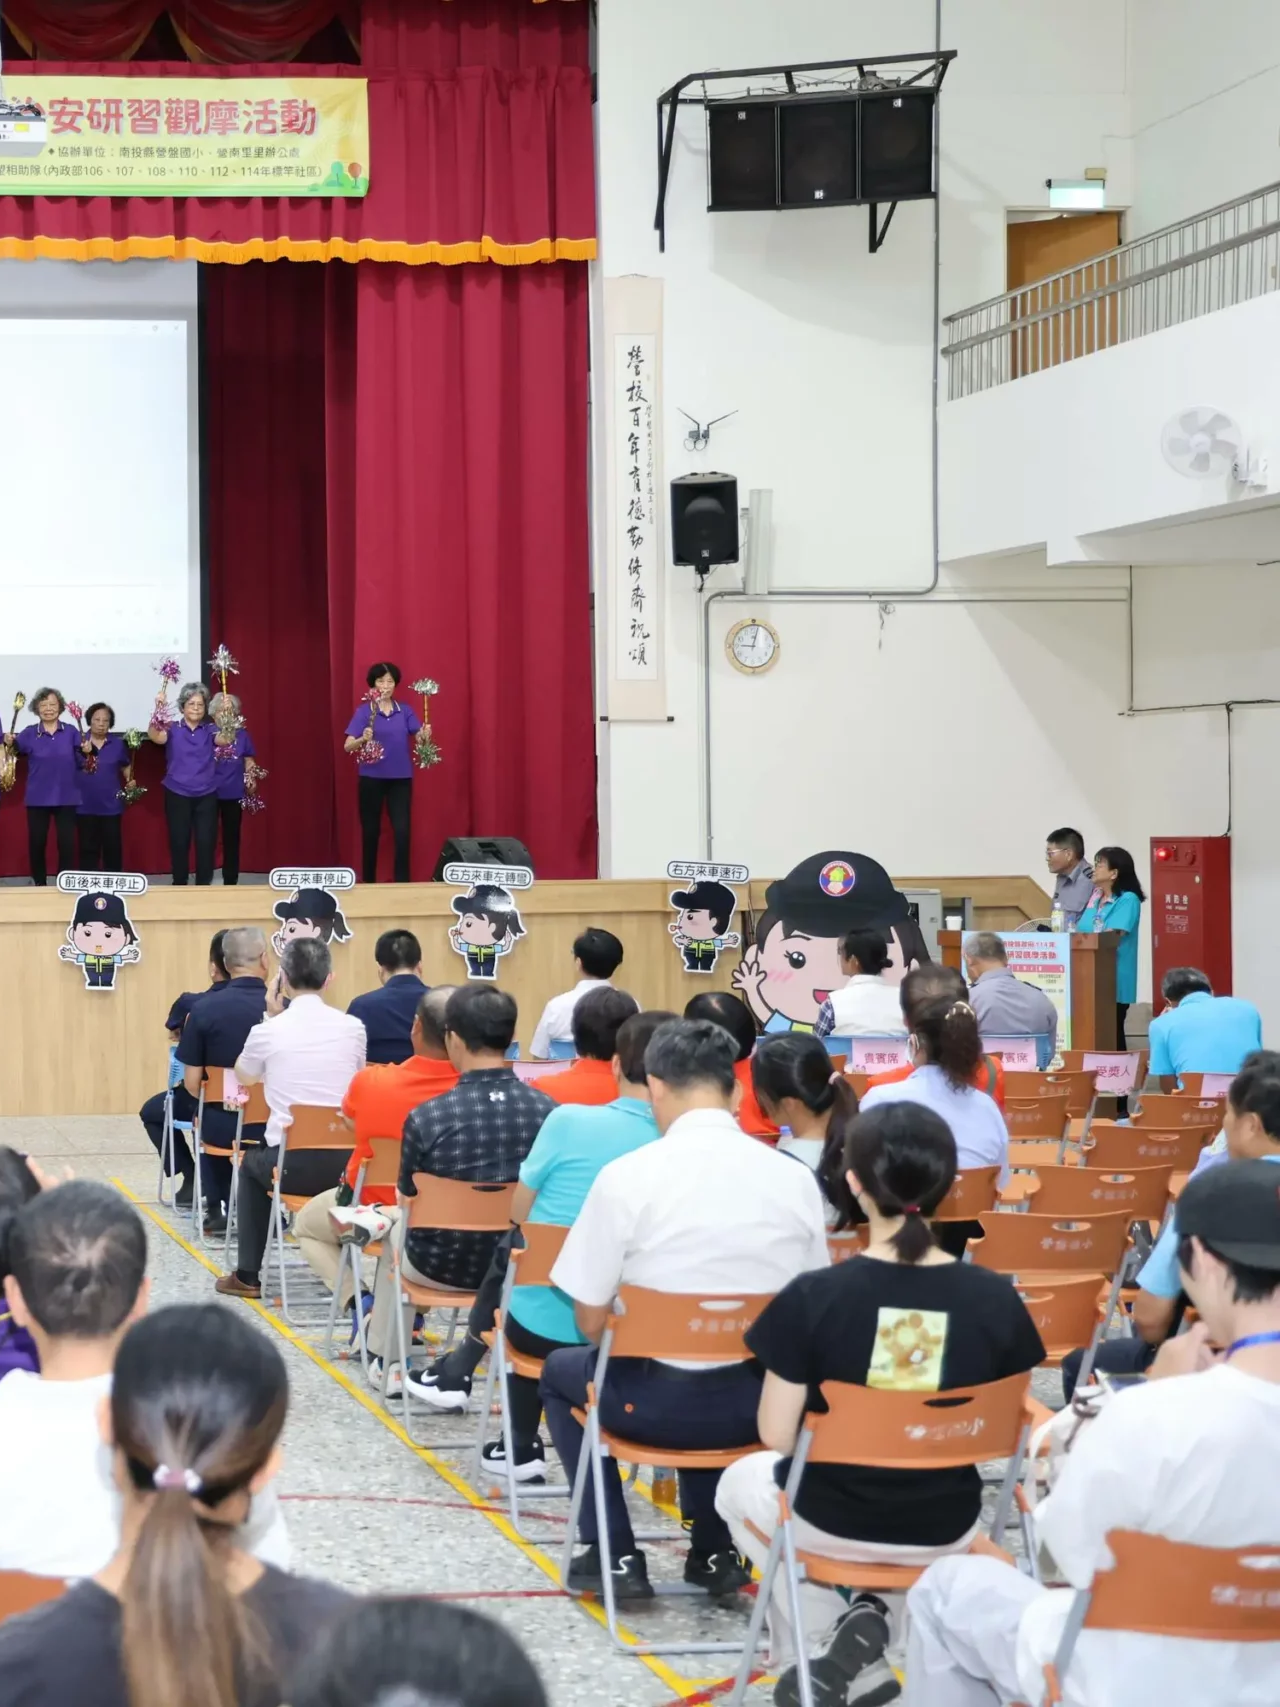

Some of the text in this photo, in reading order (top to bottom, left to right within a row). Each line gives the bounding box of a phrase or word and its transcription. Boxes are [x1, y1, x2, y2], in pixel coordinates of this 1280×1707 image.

[672, 864, 743, 880] 右方來車速行
[64, 875, 140, 890] 前後來車停止
[276, 873, 347, 885] 右方來車停止
[864, 1053, 899, 1065] 貴賓席
[1096, 1065, 1131, 1078] 受獎人
